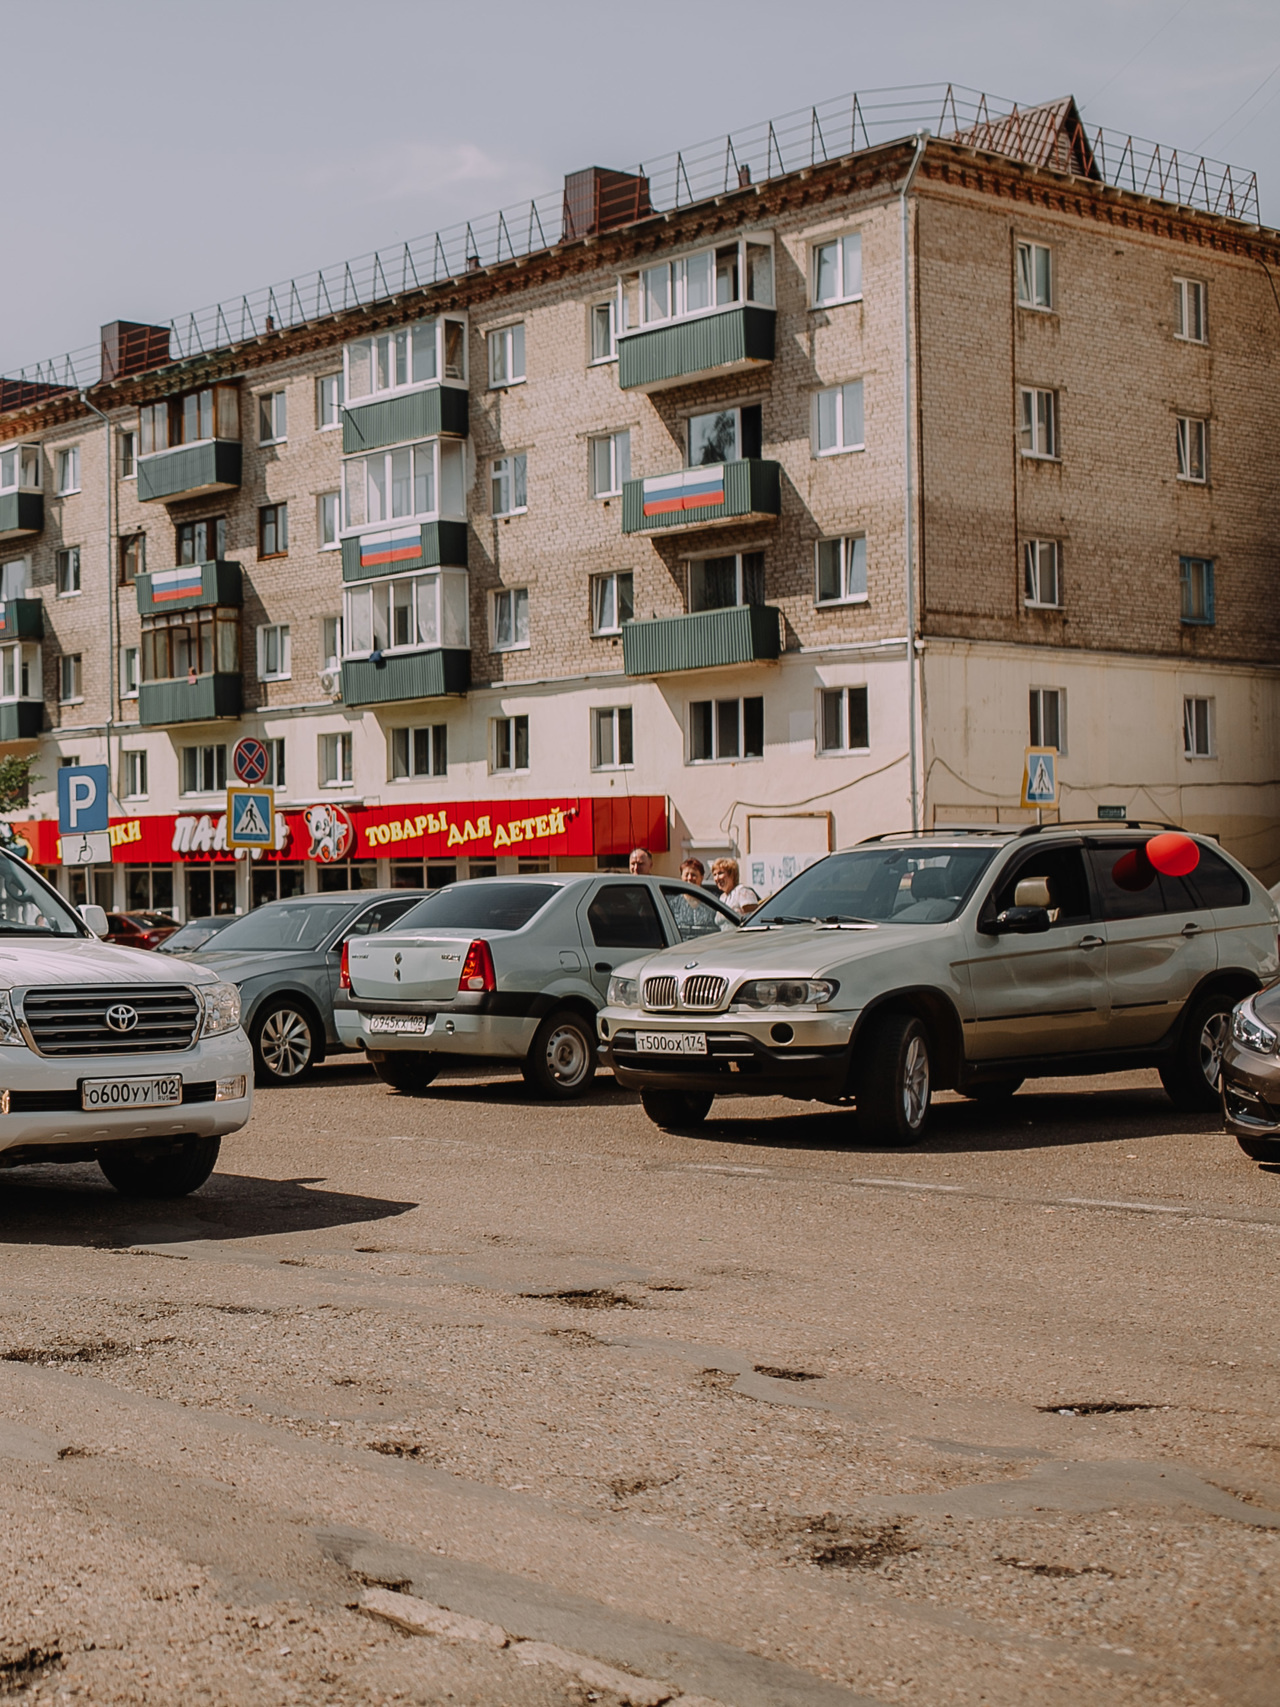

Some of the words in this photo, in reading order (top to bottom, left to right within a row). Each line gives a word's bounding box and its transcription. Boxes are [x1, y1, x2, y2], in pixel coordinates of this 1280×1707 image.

[68, 775, 97, 828] P
[365, 810, 448, 847] ТОВАРЫ
[447, 815, 492, 848] ДЛЯ
[493, 807, 566, 849] ДЕТЕЙ
[685, 1035, 704, 1048] 174
[153, 1080, 176, 1095] 102
